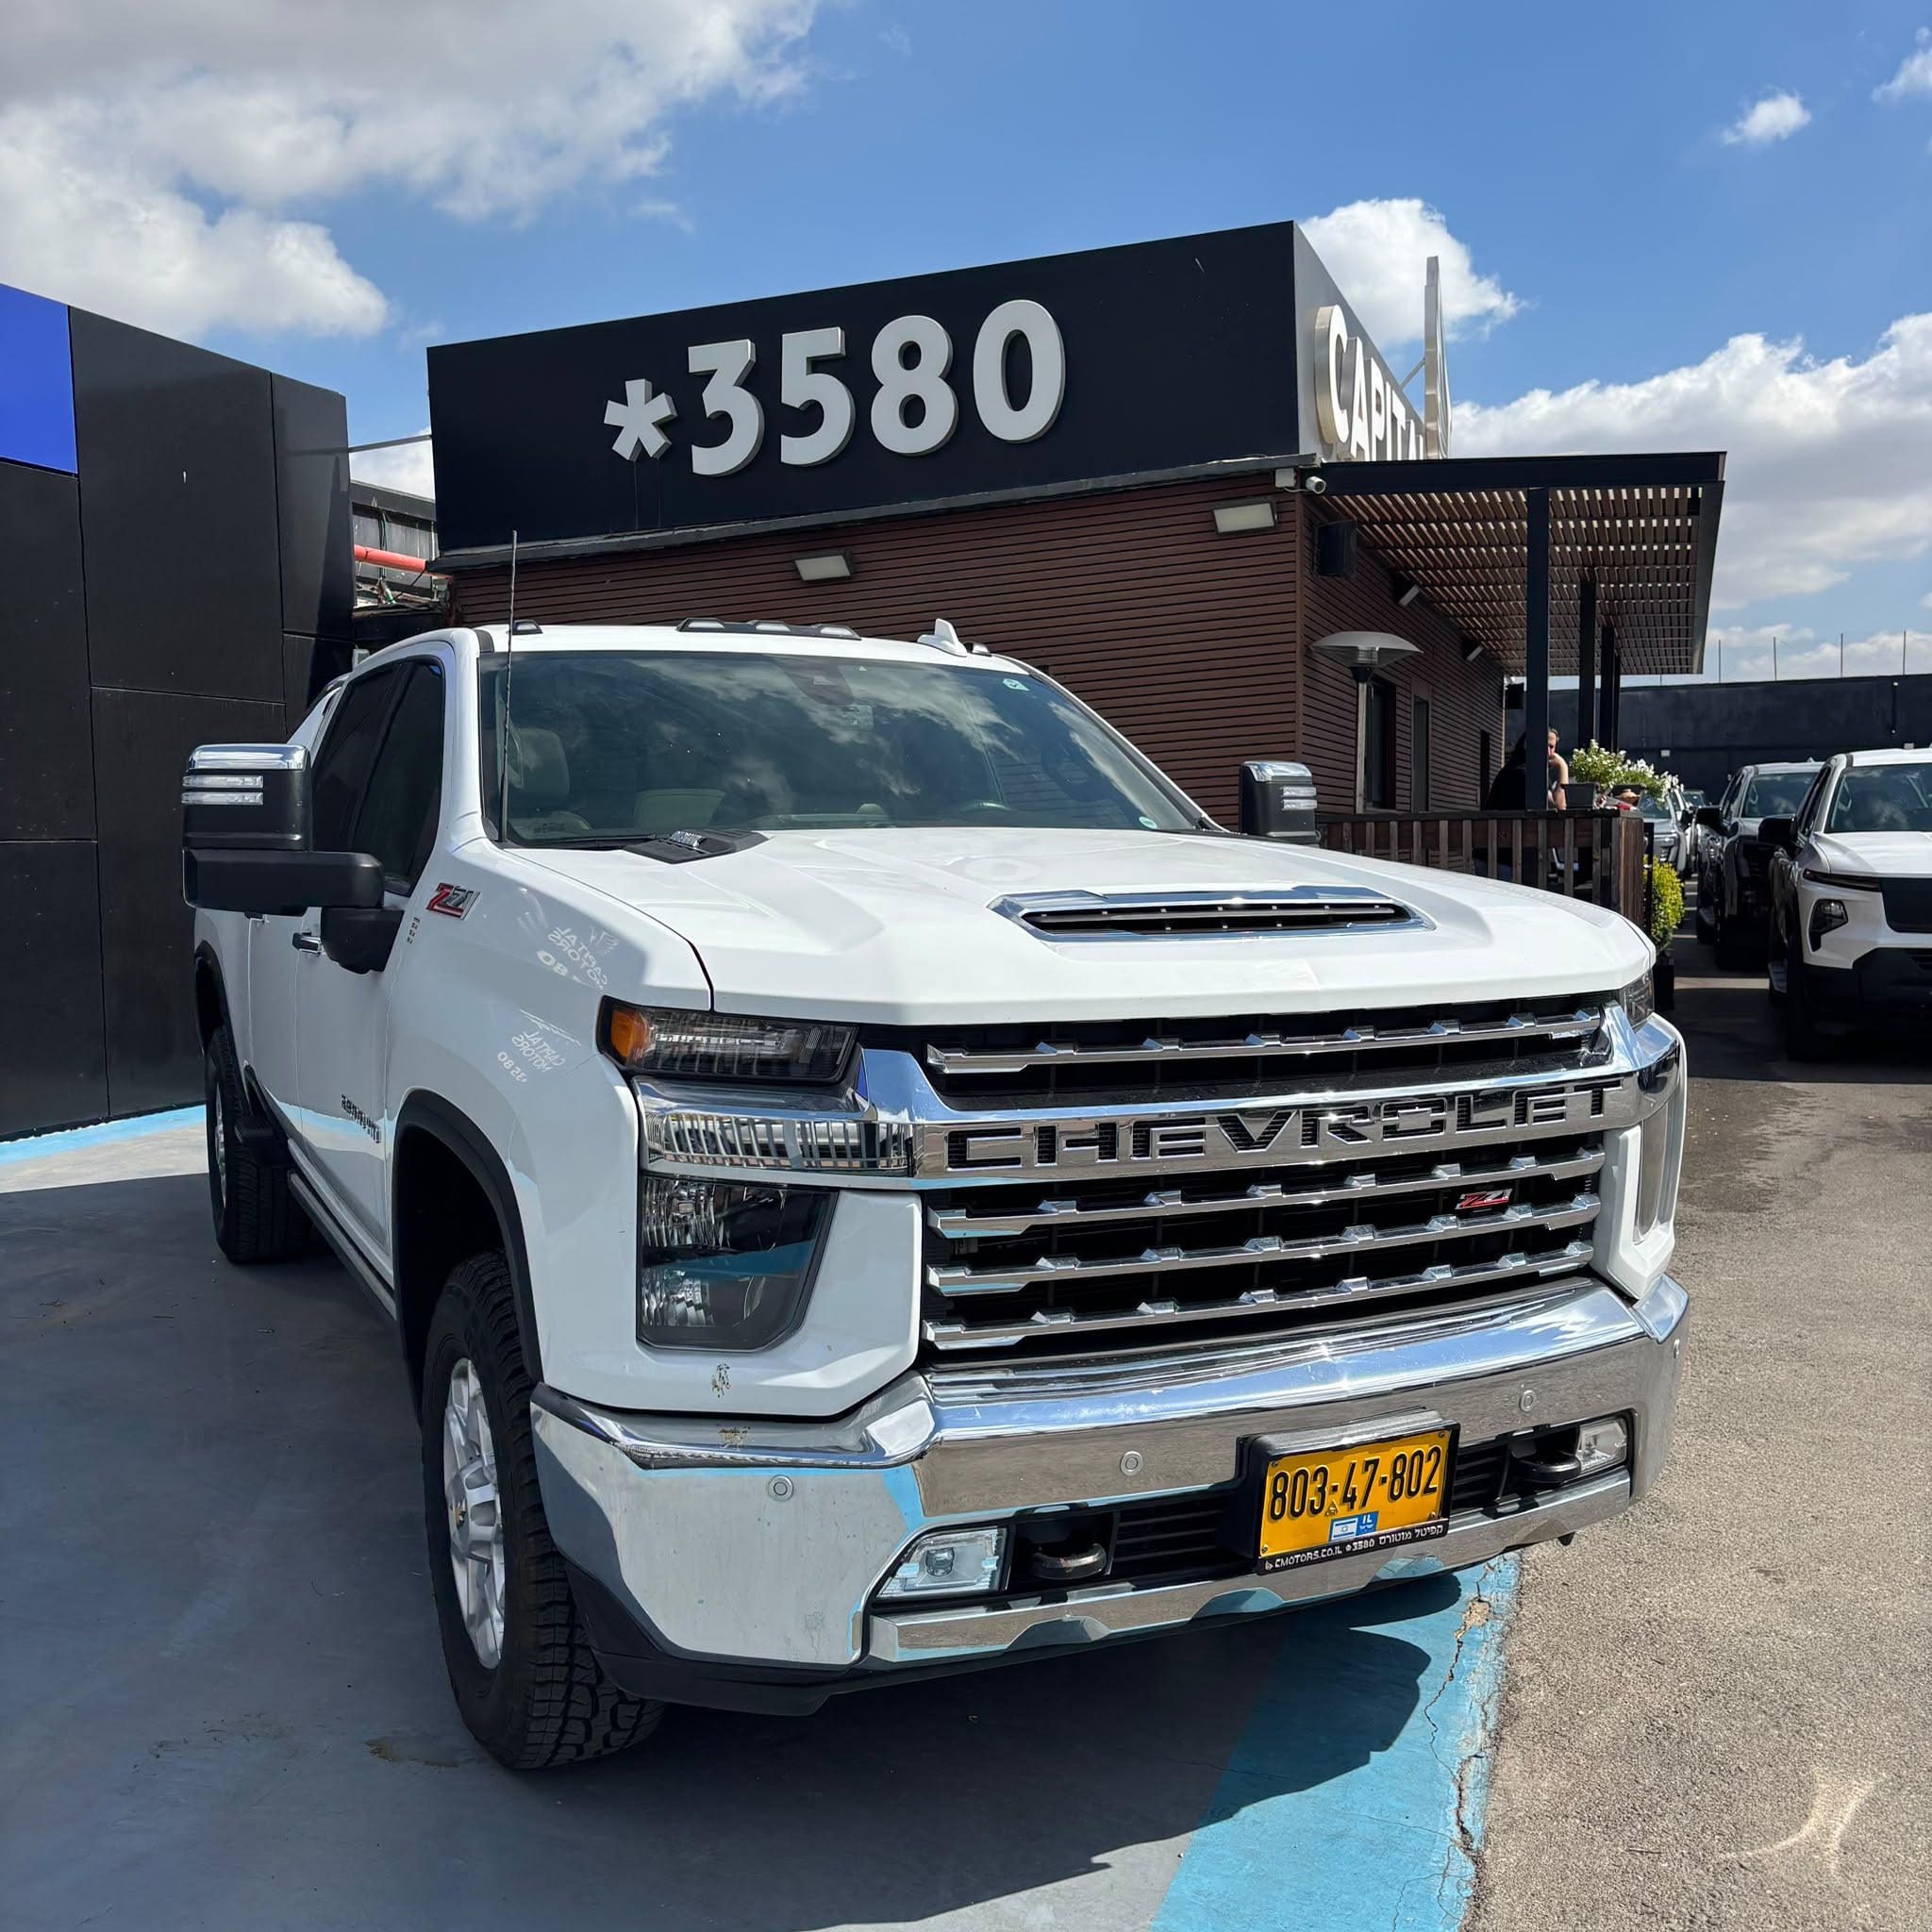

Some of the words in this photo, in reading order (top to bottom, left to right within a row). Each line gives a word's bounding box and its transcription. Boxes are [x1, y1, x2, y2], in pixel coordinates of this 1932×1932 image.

[946, 1078, 1624, 1170] CHEVROLET
[1362, 1514, 1373, 1524] IL
[1378, 1530, 1412, 1545] מוטורס
[1414, 1524, 1444, 1540] קפיטל
[1274, 1545, 1342, 1569] CMOTORS.CO.IL
